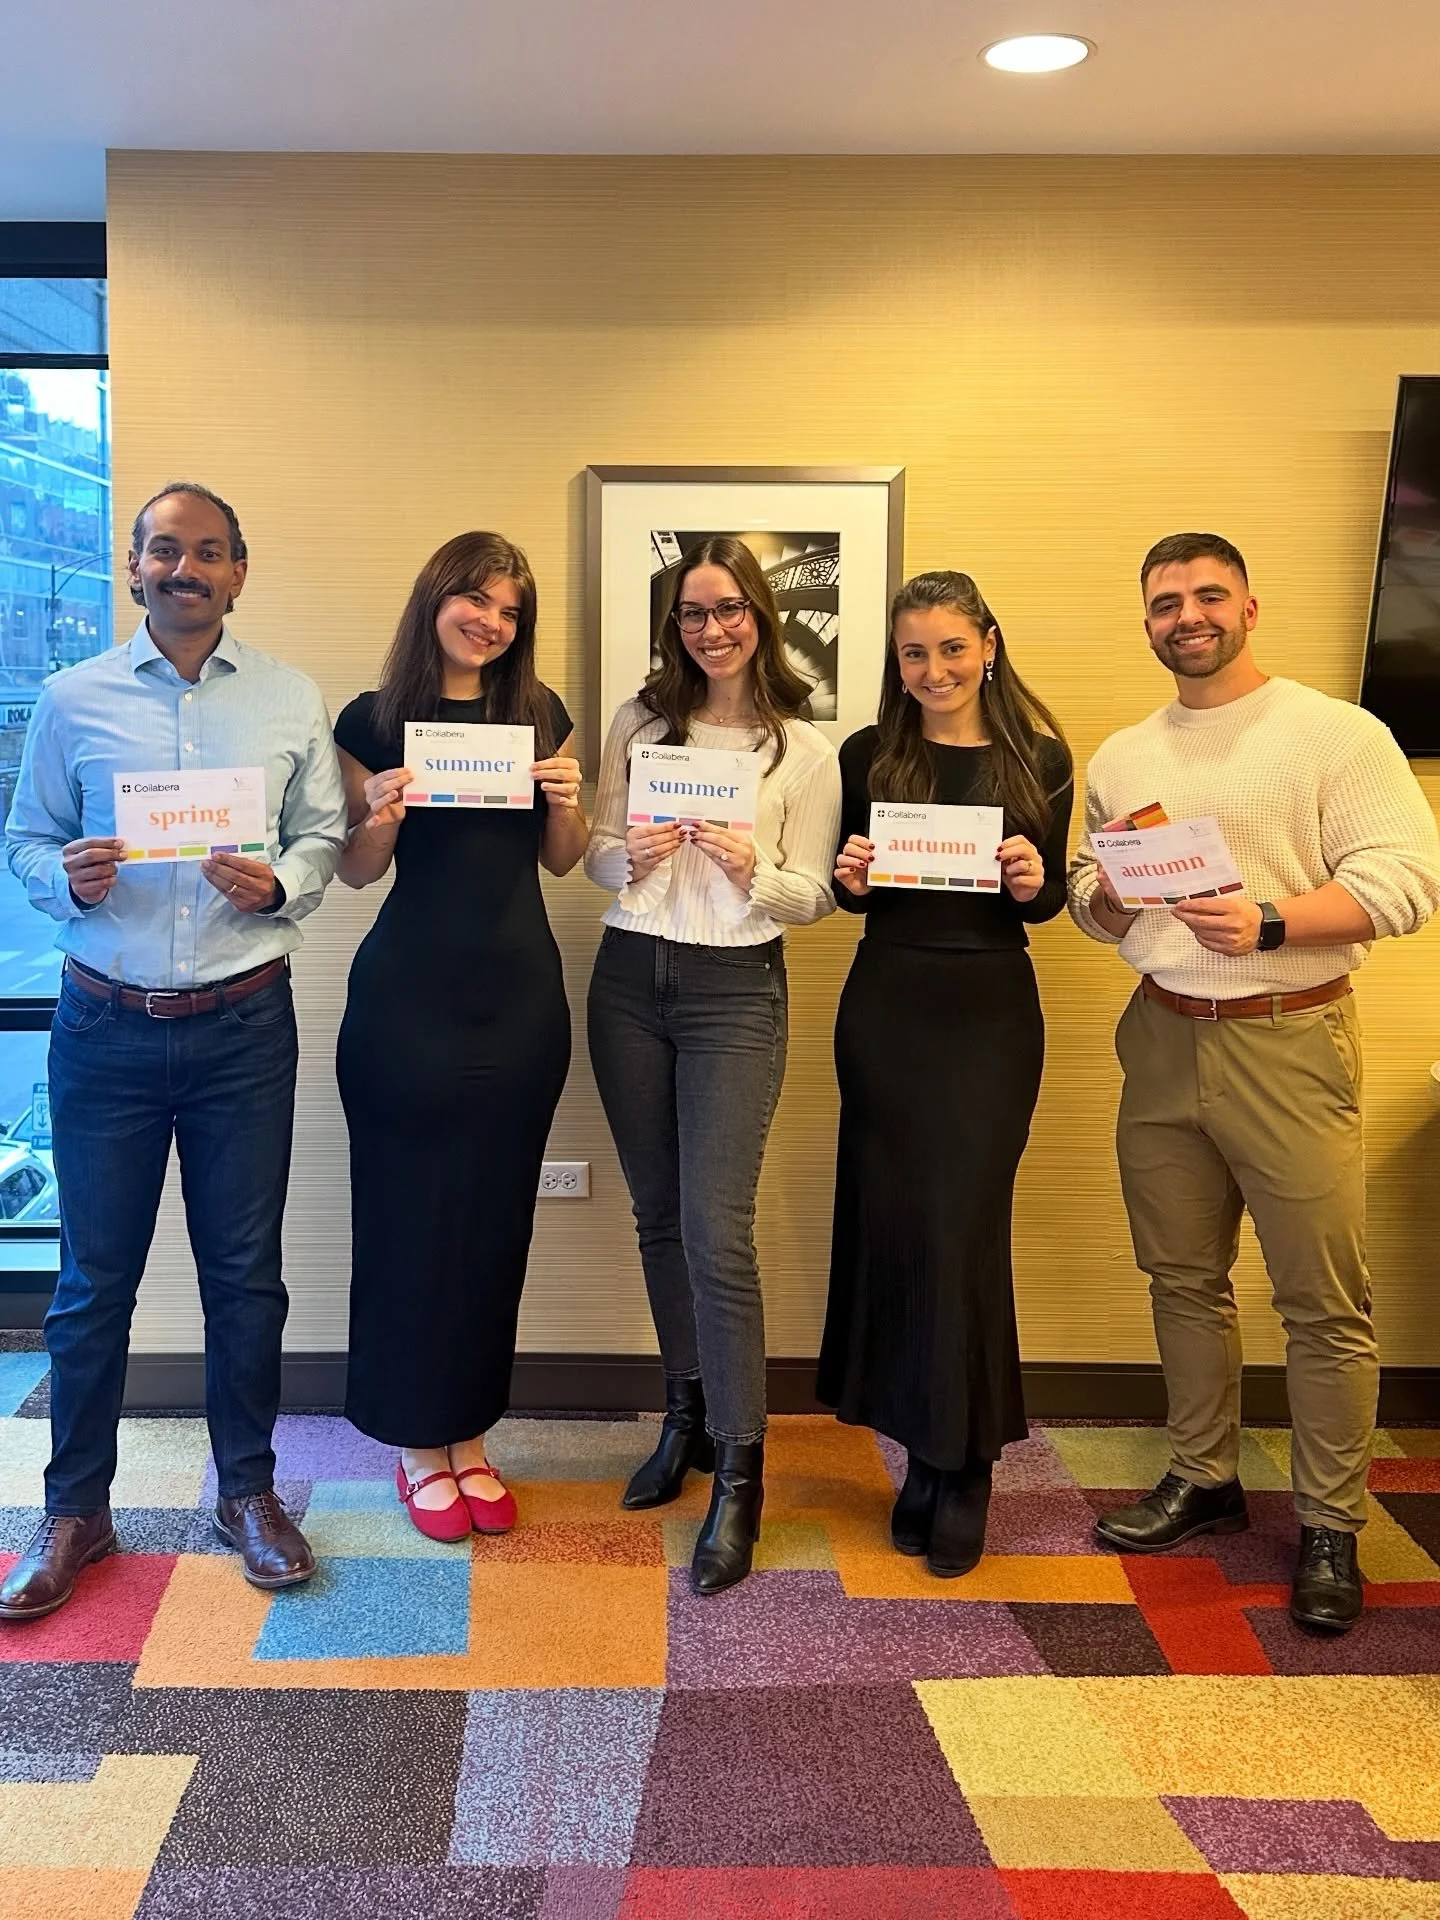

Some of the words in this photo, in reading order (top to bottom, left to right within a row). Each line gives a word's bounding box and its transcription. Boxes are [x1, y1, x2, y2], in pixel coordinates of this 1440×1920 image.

[425, 729, 465, 738] Collabera
[651, 751, 690, 761] Collabera
[425, 758, 516, 773] summer
[134, 783, 180, 793] Collabera
[648, 780, 740, 799] summer
[148, 804, 231, 831] spring
[887, 810, 927, 820] Collabera
[888, 837, 977, 855] autumn
[1106, 838, 1142, 848] Collabera
[1121, 856, 1206, 878] autumn
